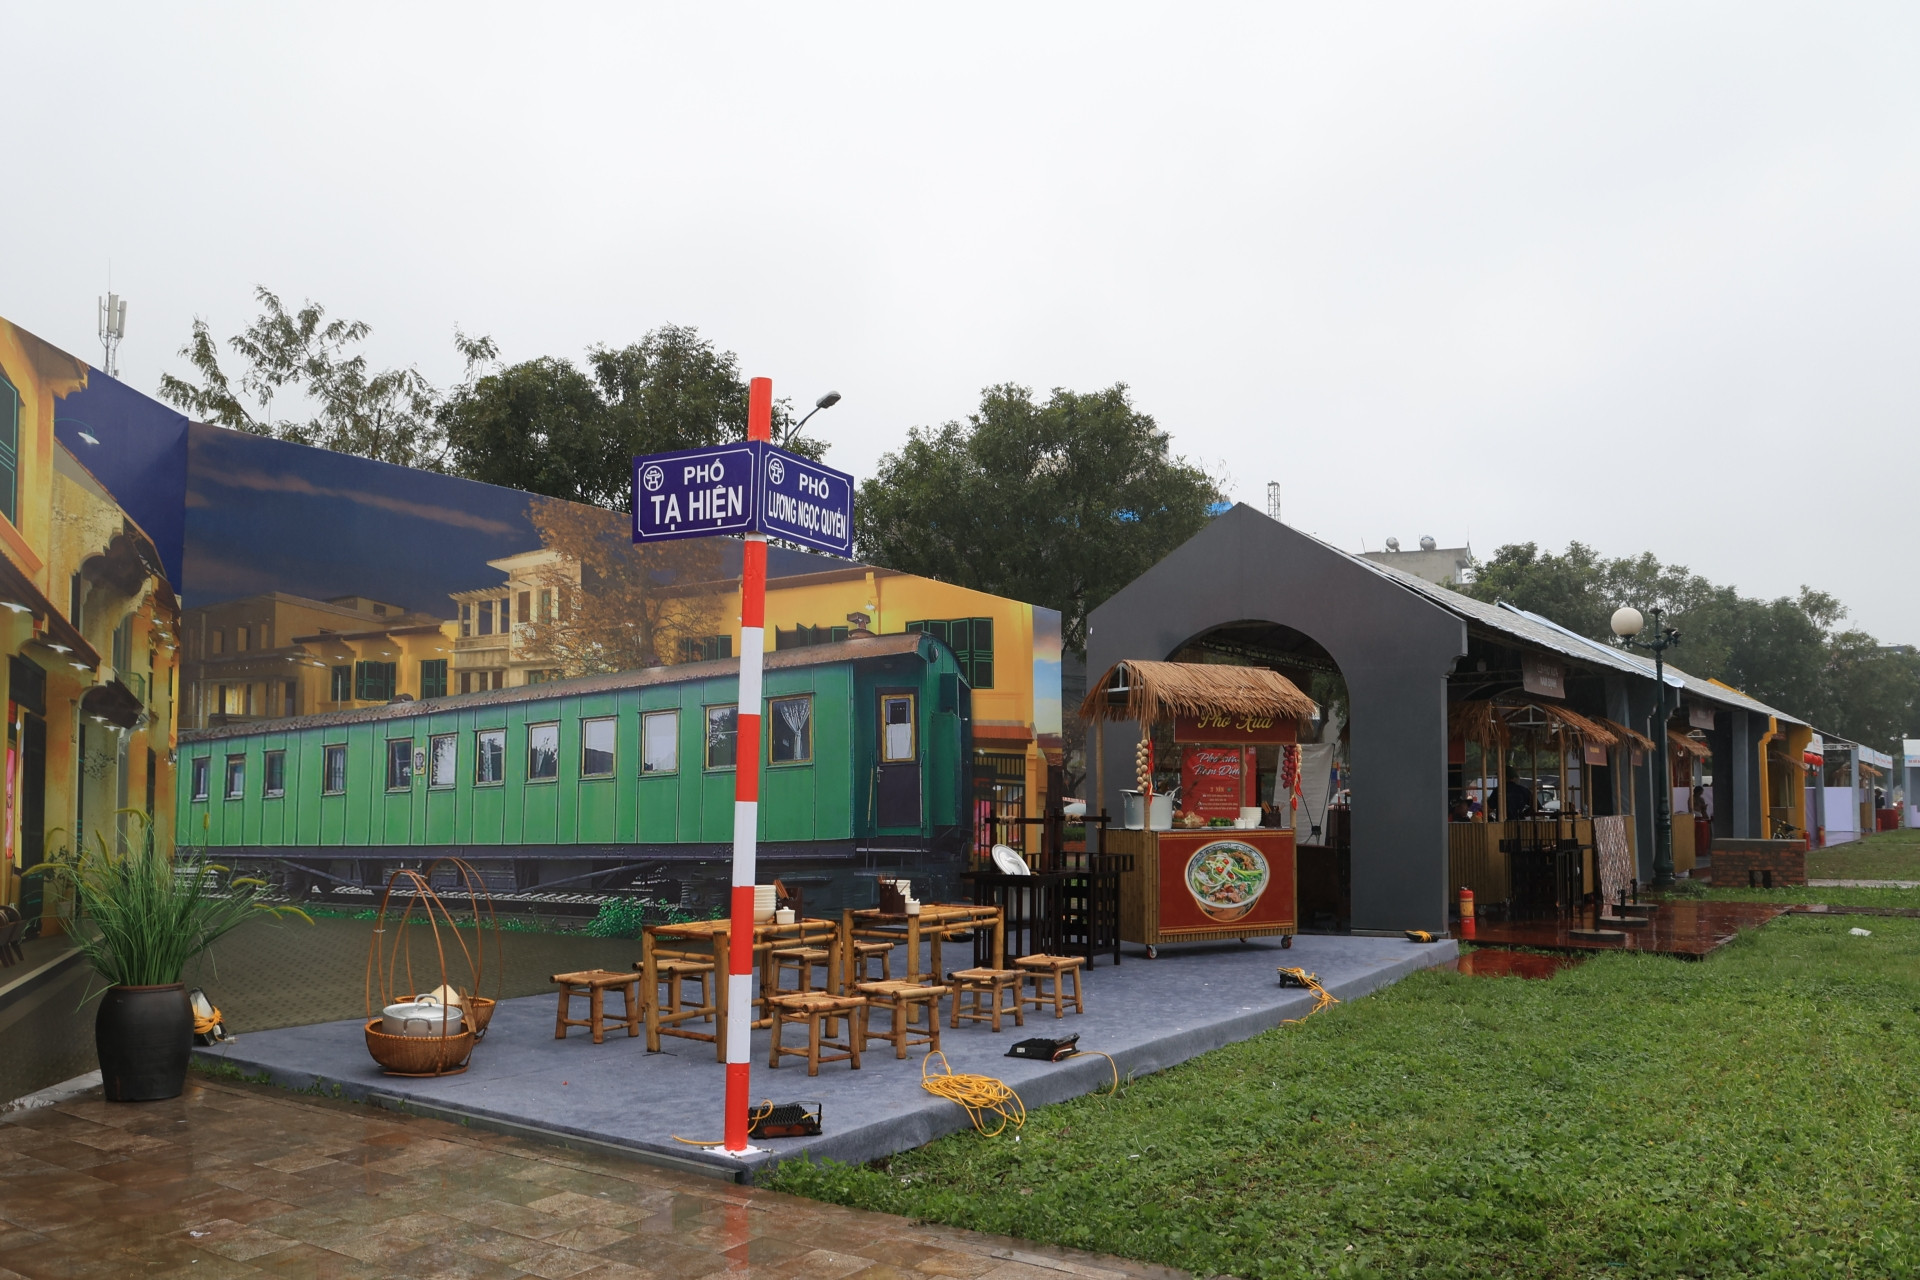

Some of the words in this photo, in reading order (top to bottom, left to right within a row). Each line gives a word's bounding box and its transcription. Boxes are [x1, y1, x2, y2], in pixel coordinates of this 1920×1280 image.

[683, 457, 725, 486] PHỐ
[799, 473, 830, 500] PHỐ
[650, 493, 682, 531] TẠ
[688, 484, 743, 526] HIỆN
[768, 490, 797, 525] LƯƠNG
[797, 500, 820, 536] NGỌC
[820, 507, 846, 540] QUYẾN
